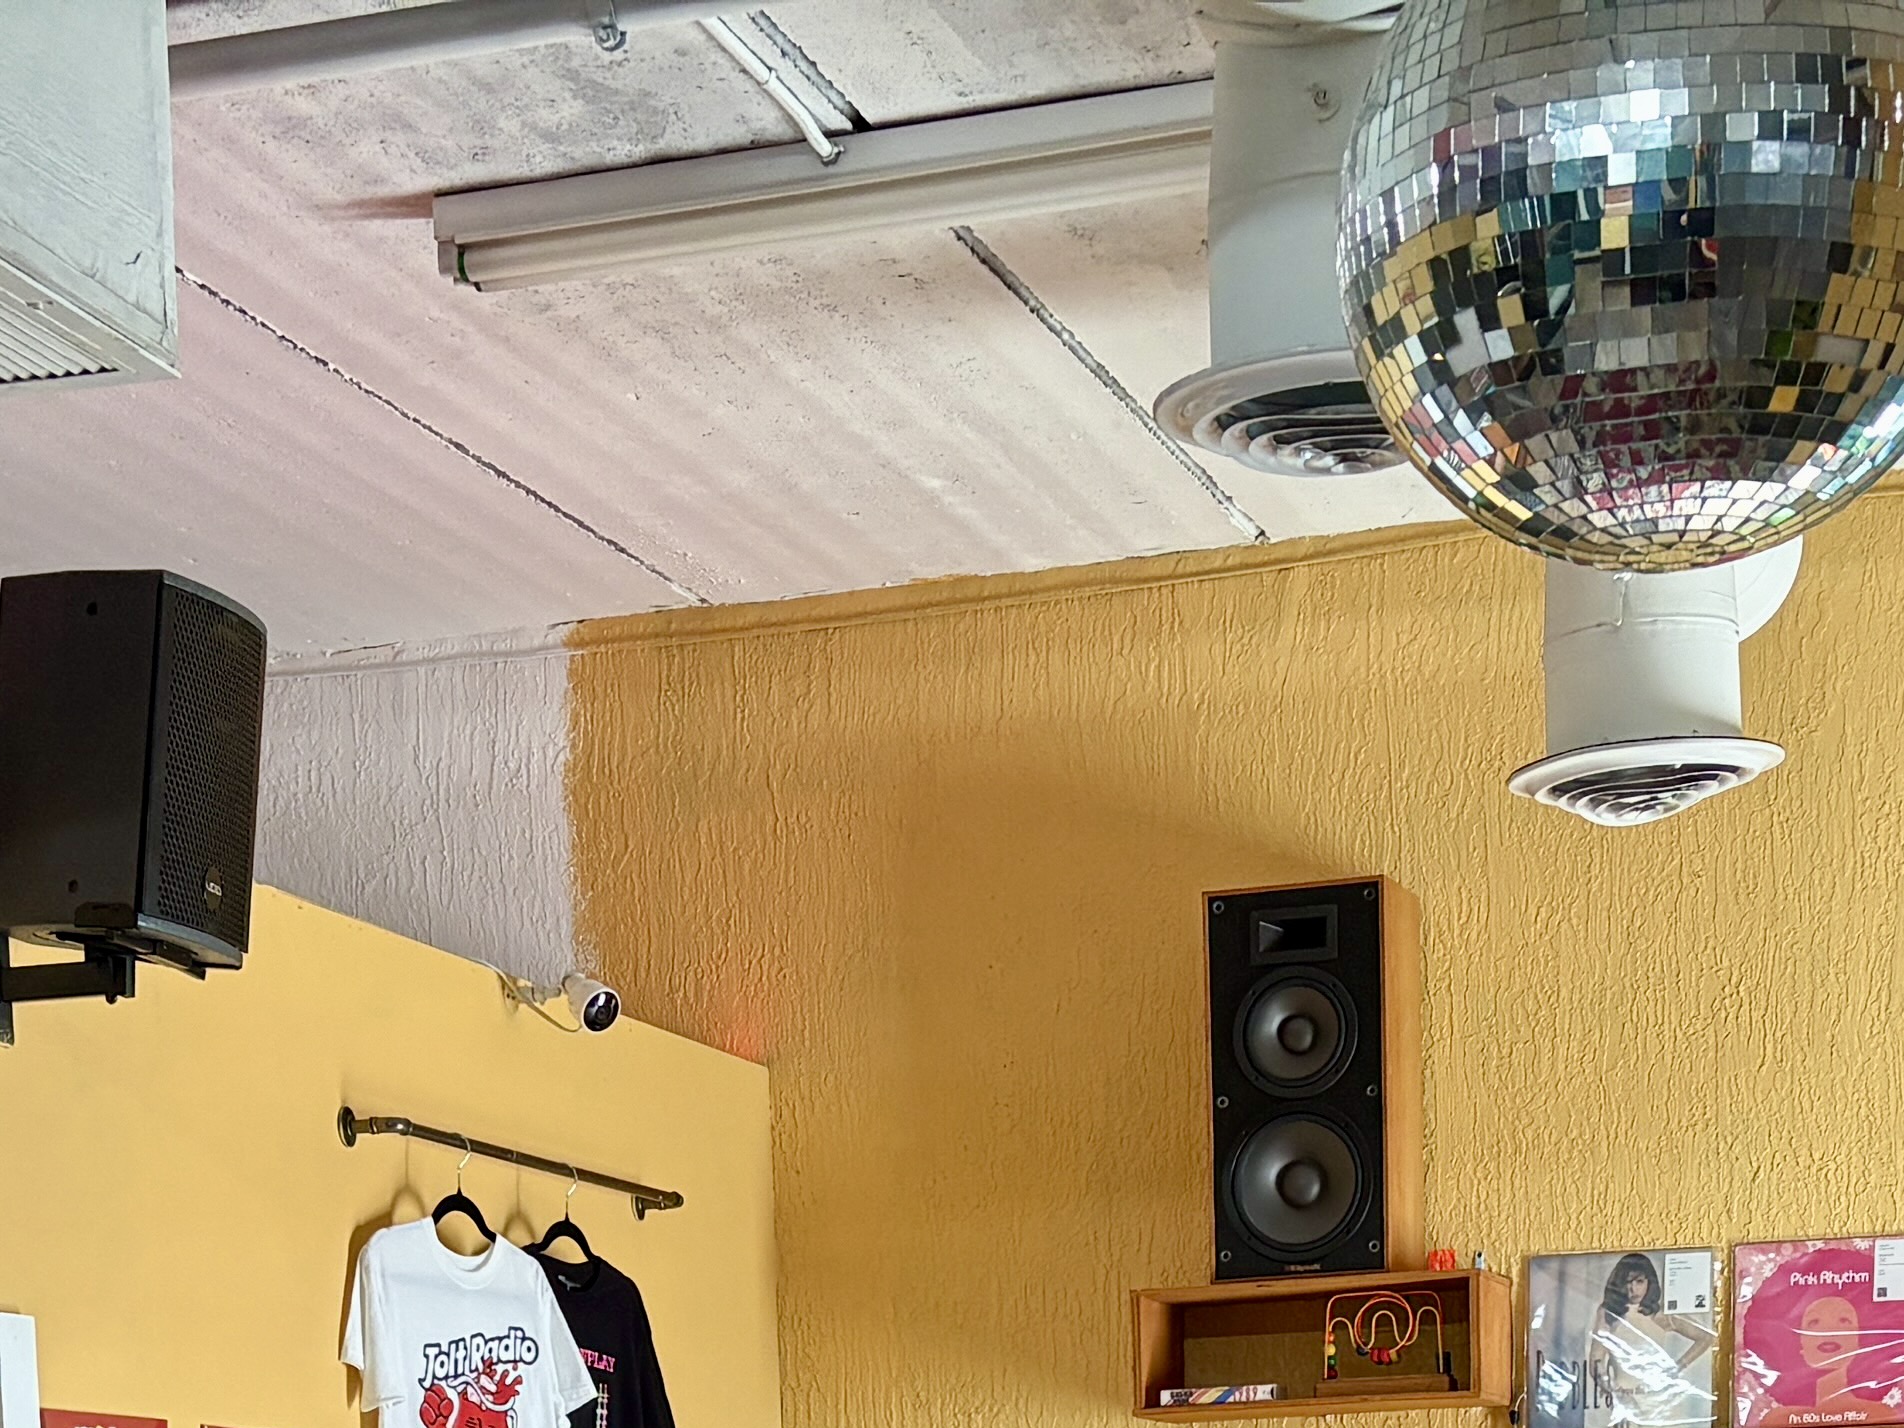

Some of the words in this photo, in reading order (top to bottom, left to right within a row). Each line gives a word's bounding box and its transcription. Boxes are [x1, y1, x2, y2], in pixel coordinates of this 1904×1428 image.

[1790, 1271, 1818, 1287] Pink
[1819, 1269, 1870, 1290] Rhythm
[418, 1336, 470, 1389] Jolt
[469, 1326, 539, 1374] Radio
[1821, 1411, 1843, 1423] Love
[1843, 1410, 1869, 1423] Affair
